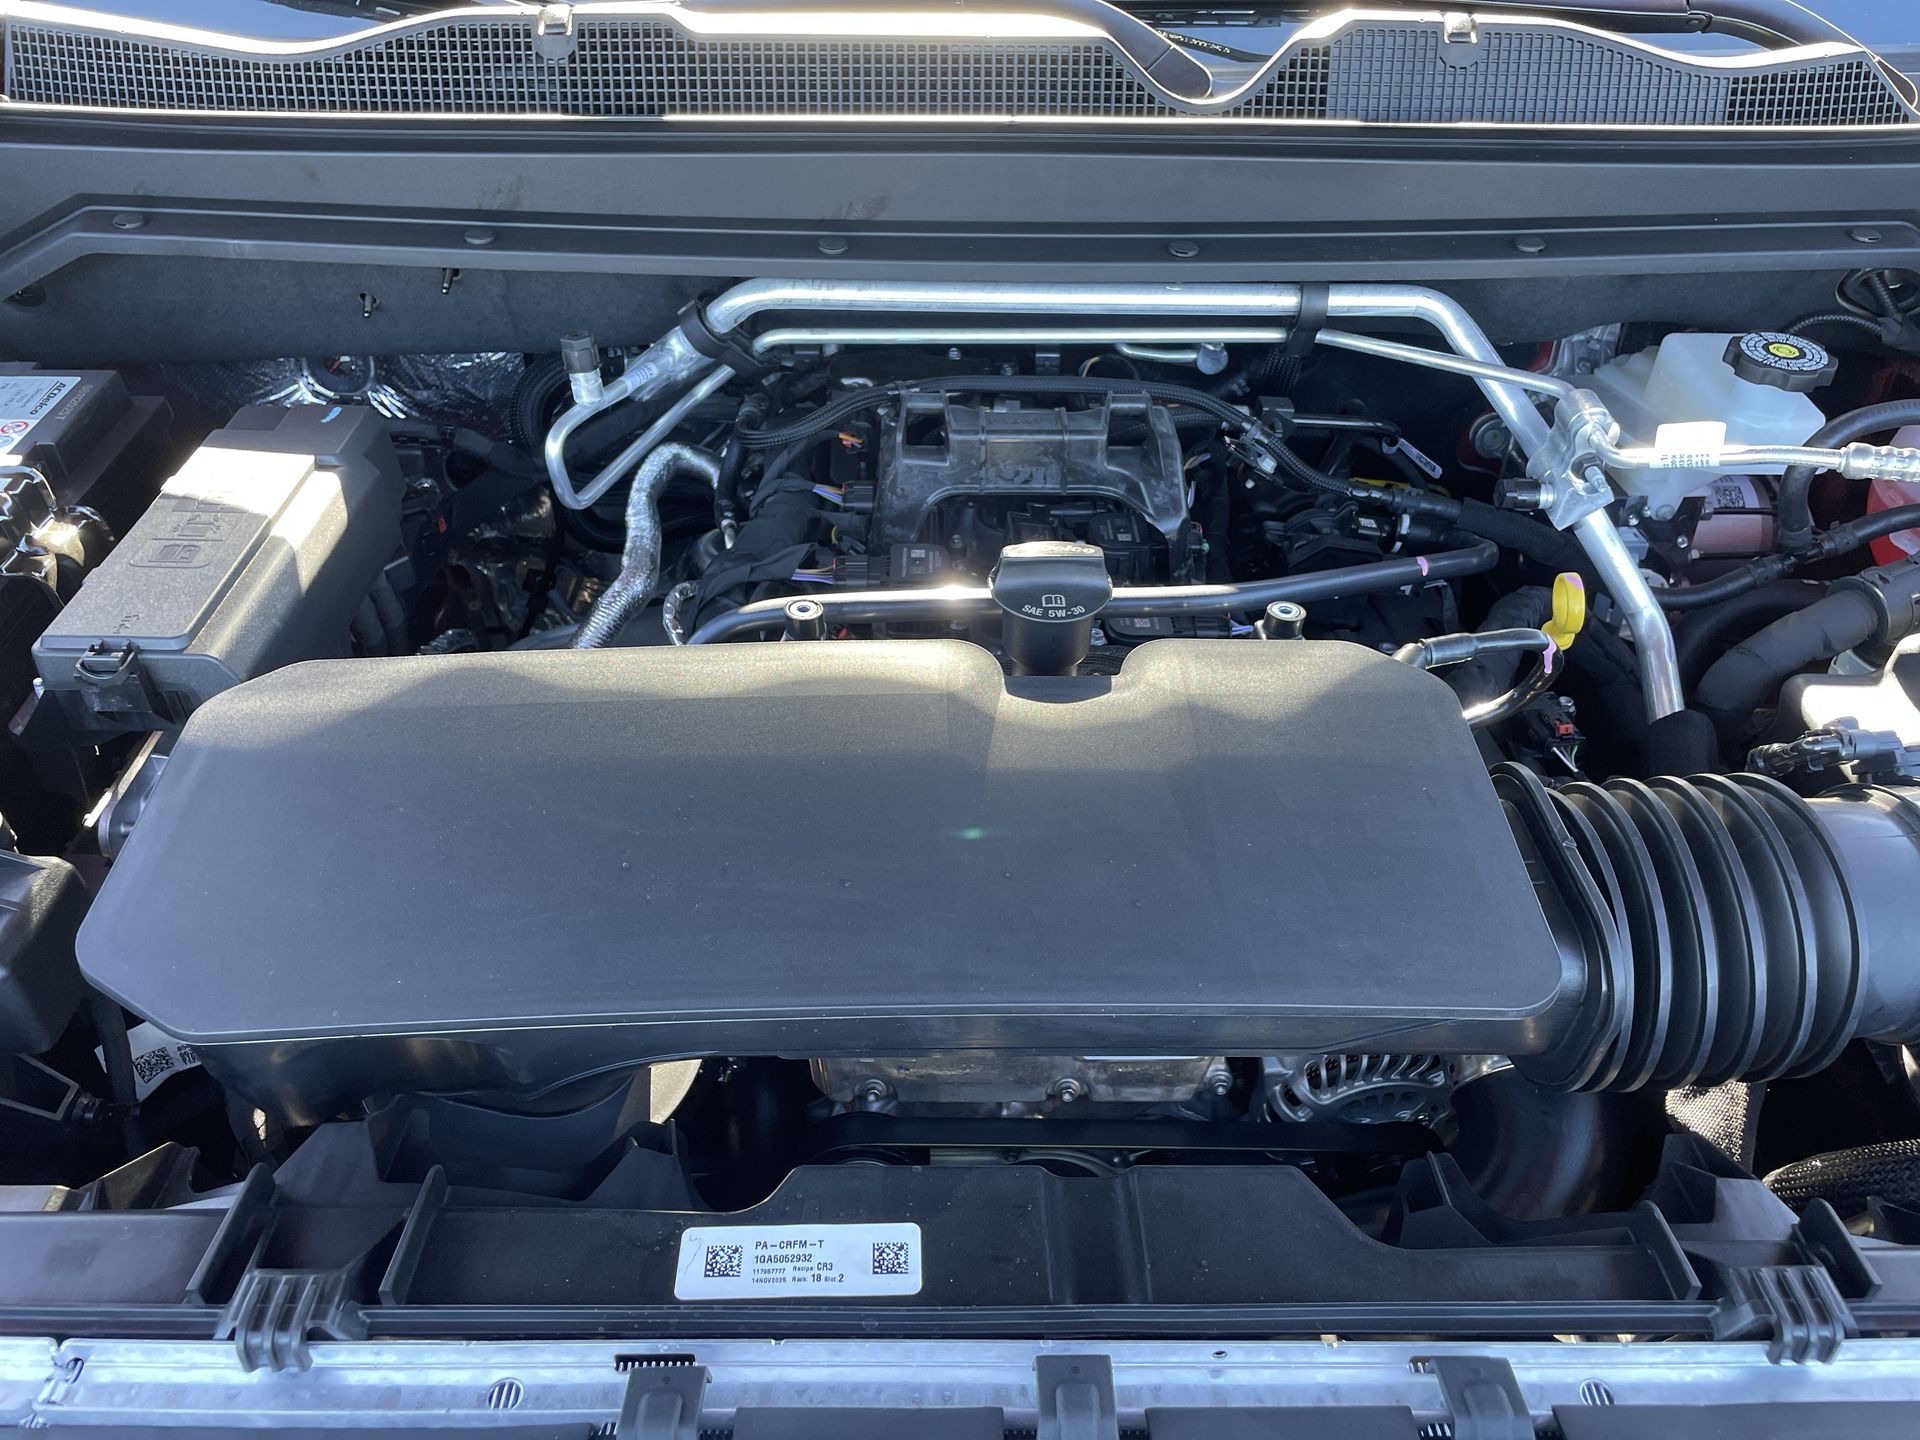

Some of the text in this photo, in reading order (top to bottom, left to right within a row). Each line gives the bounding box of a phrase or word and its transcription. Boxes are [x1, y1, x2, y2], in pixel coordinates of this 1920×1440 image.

[1022, 604, 1086, 618] SAE 5W-30
[816, 1262, 834, 1272] CR3
[811, 1273, 821, 1282] 18
[838, 1273, 844, 1282] 2
